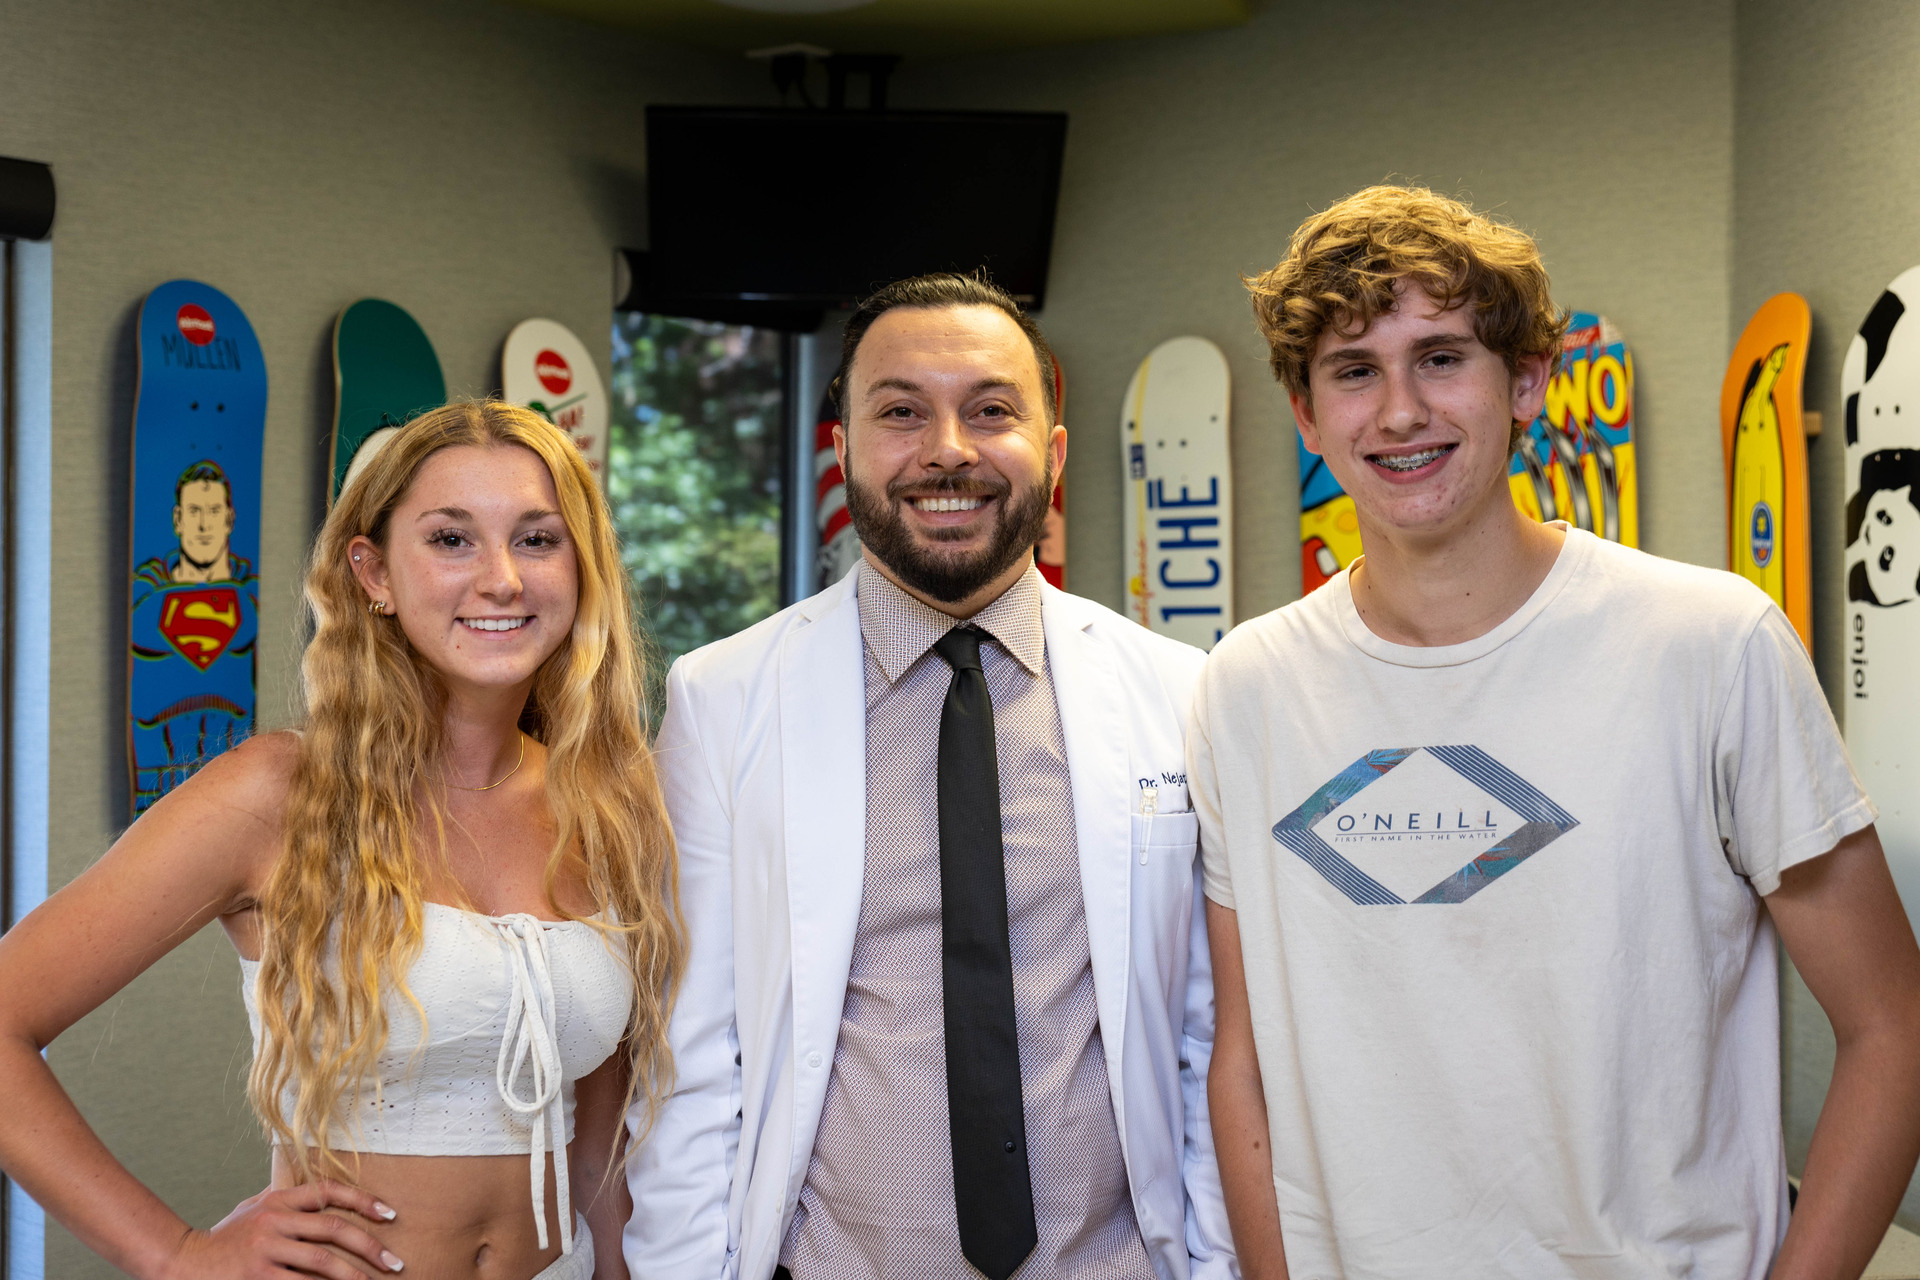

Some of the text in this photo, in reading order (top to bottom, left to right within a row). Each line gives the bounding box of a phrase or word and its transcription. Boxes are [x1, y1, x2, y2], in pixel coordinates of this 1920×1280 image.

[161, 332, 241, 373] MULLEN
[1545, 353, 1630, 438] WO
[1850, 612, 1869, 699] enjoi
[1138, 777, 1158, 790] Dr.
[1336, 810, 1498, 832] O'NEILL
[1334, 835, 1364, 843] FIRST
[1371, 834, 1402, 842] NAME
[1458, 832, 1497, 840] WATER
